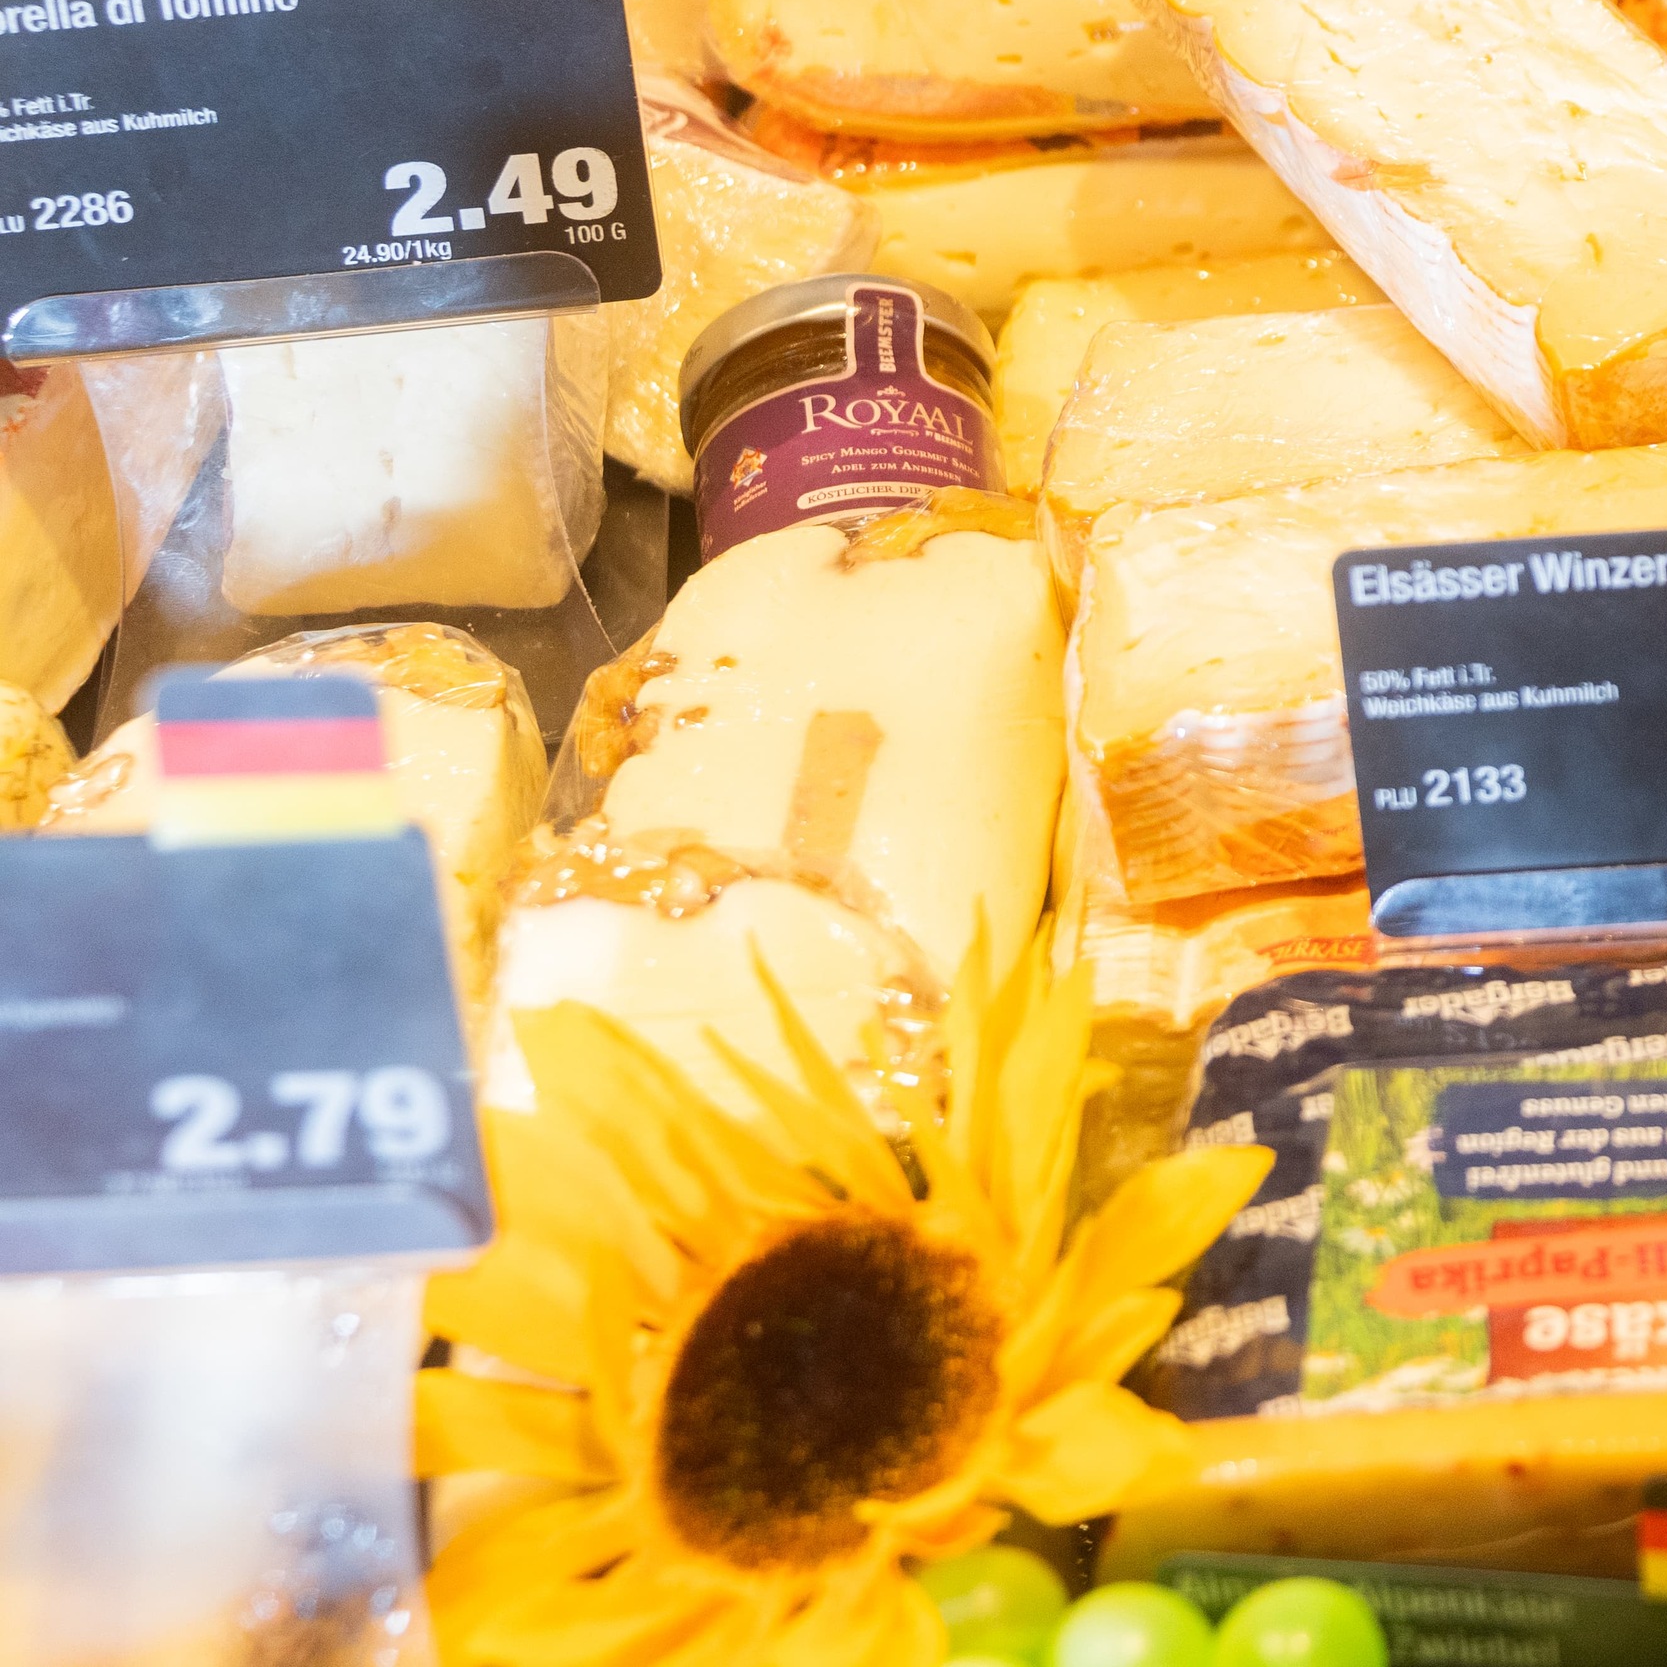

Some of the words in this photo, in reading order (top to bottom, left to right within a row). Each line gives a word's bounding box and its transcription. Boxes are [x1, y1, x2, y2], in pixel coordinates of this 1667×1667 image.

[12, 94, 57, 117] Fett
[81, 117, 119, 135] aus
[121, 107, 219, 131] Kuhmilch
[383, 146, 618, 238] 2.49
[30, 190, 134, 231] 2286
[342, 238, 452, 268] 24.90/1kg
[564, 222, 606, 246] 100
[611, 221, 628, 242] G
[877, 296, 897, 373] BEEMSTER
[798, 393, 974, 446] ROYAAL
[801, 451, 835, 466] SPICY
[840, 446, 888, 458] MANGO
[892, 445, 948, 464] GOURMET
[934, 434, 974, 455] BEEMSTER
[831, 462, 867, 475] ADEL
[870, 461, 898, 471] ZUM
[901, 460, 962, 483] ANBEISSEN
[807, 484, 893, 504] KÖSTLICHER
[898, 485, 923, 496] DIP
[1349, 558, 1524, 607] Elsässer
[1411, 663, 1456, 690] Fett
[1362, 692, 1477, 720] Weichkäse
[1478, 689, 1519, 713] aus
[1520, 680, 1620, 710] Kuhmilch
[1374, 786, 1418, 811] PLU
[1422, 763, 1527, 809] 2133
[1403, 979, 1577, 1026] Bergader
[149, 1066, 452, 1171] 2.79
[1521, 1095, 1624, 1119] Genuss
[1456, 1126, 1556, 1156] Region
[1560, 1127, 1609, 1152] der
[1612, 1125, 1662, 1149] aus
[1465, 1155, 1610, 1191] glutenfrei
